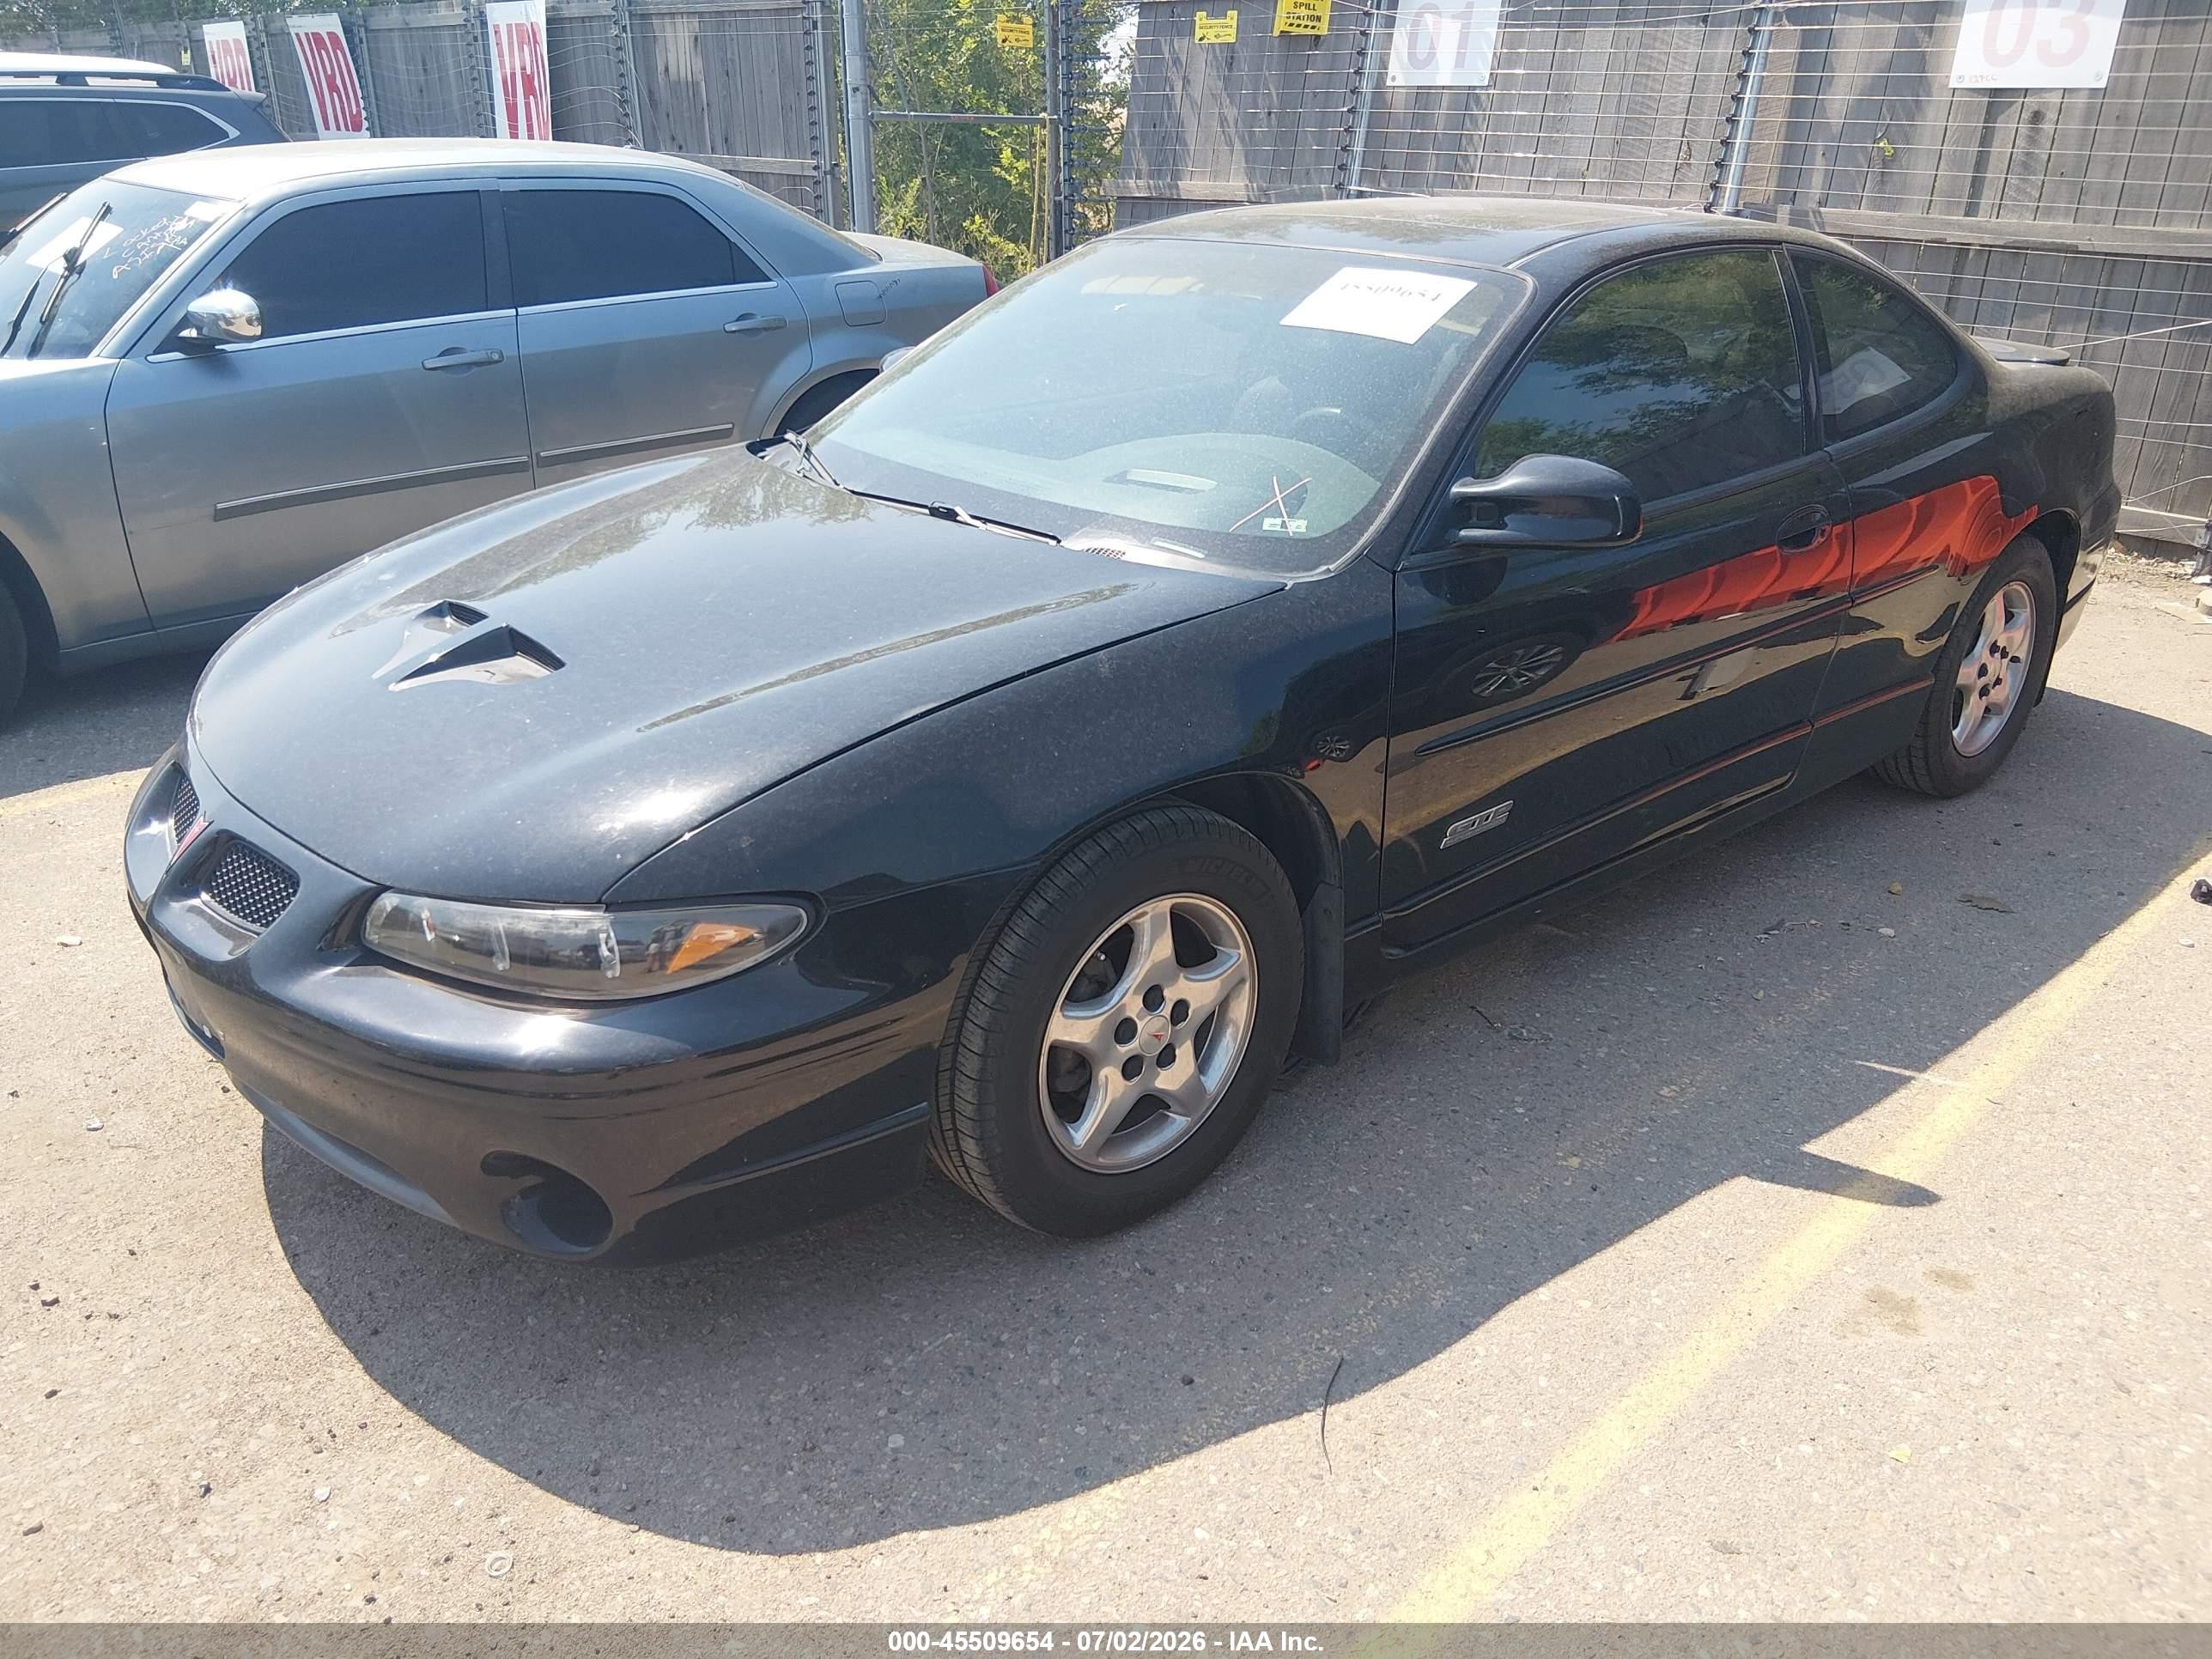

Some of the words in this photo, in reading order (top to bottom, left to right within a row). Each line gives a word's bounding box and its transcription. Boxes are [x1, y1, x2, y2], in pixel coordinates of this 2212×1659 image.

[1285, 11, 1322, 23] STATION
[1292, 1, 1317, 11] SPILL
[1407, 2, 1474, 70] 01
[1983, 0, 2095, 68] 03
[295, 31, 363, 132] VRD
[493, 21, 550, 141] VRD
